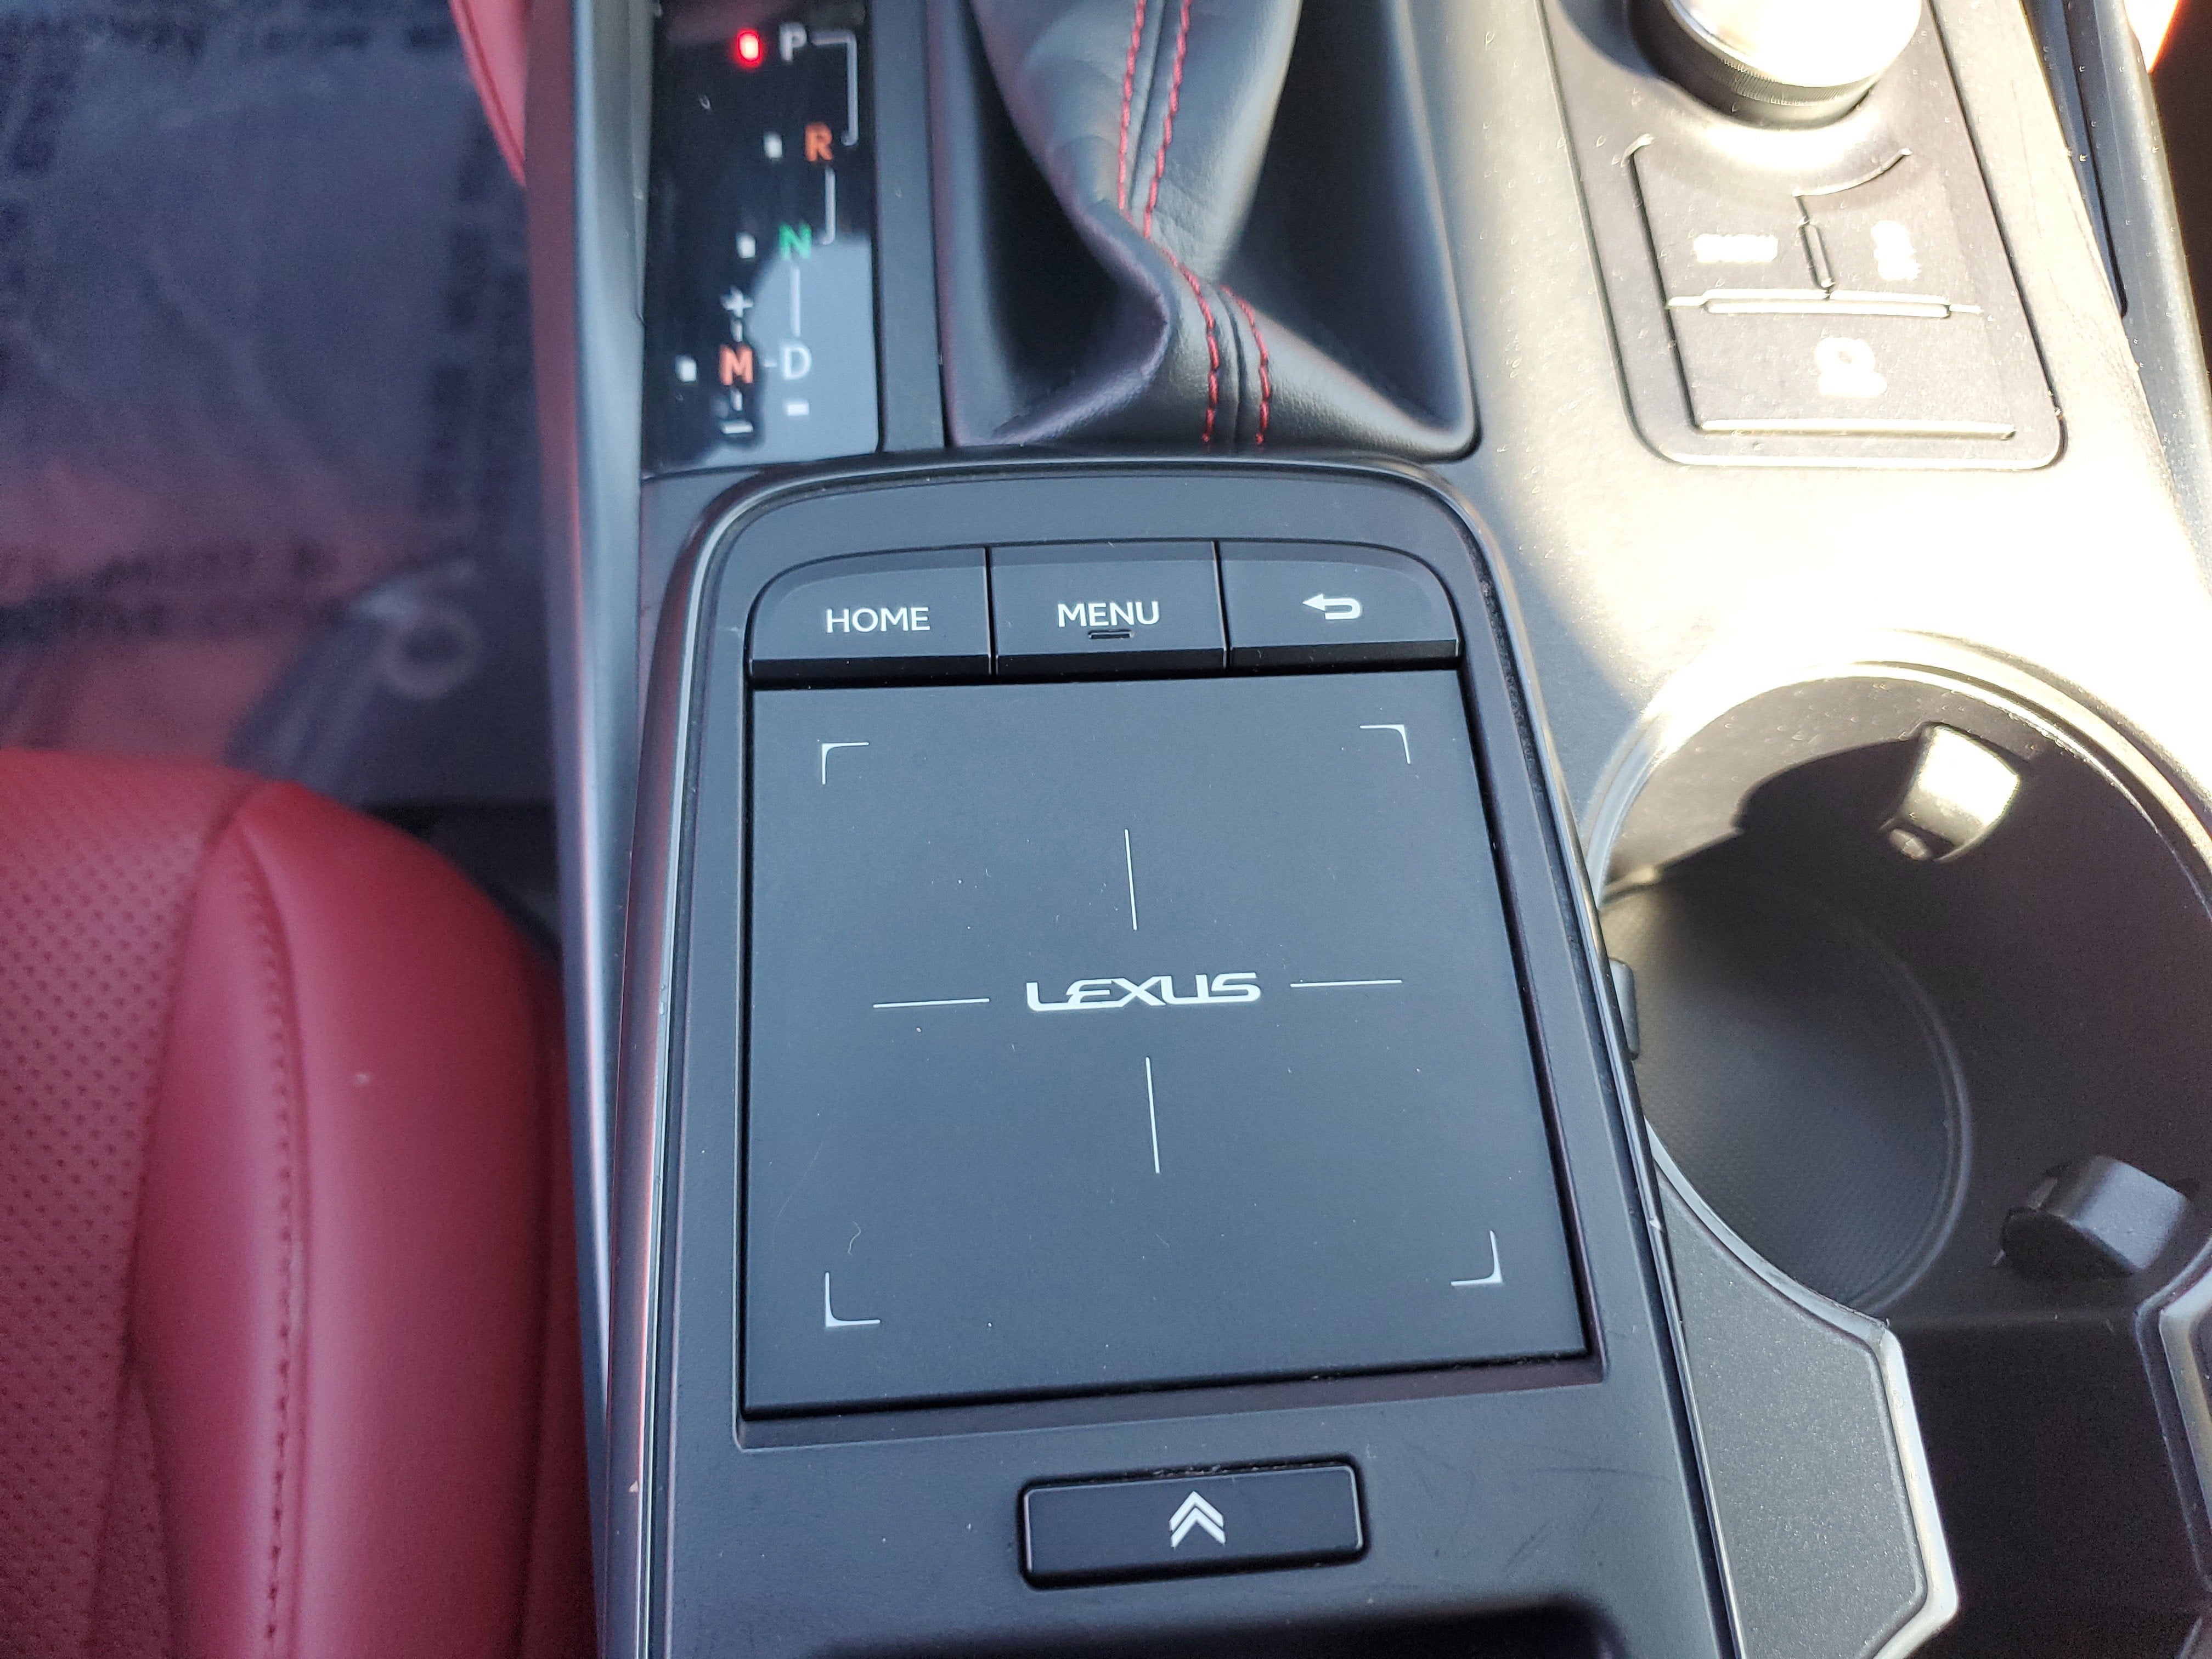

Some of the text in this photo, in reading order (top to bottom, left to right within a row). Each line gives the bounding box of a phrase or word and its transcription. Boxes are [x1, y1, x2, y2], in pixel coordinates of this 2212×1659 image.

[779, 22, 807, 63] P
[804, 122, 833, 162] R
[778, 224, 812, 260] N
[719, 345, 753, 386] M
[782, 343, 812, 380] D
[827, 607, 930, 633] HOME
[1057, 601, 1160, 627] MENU
[1026, 972, 1261, 1011] LEXUS
